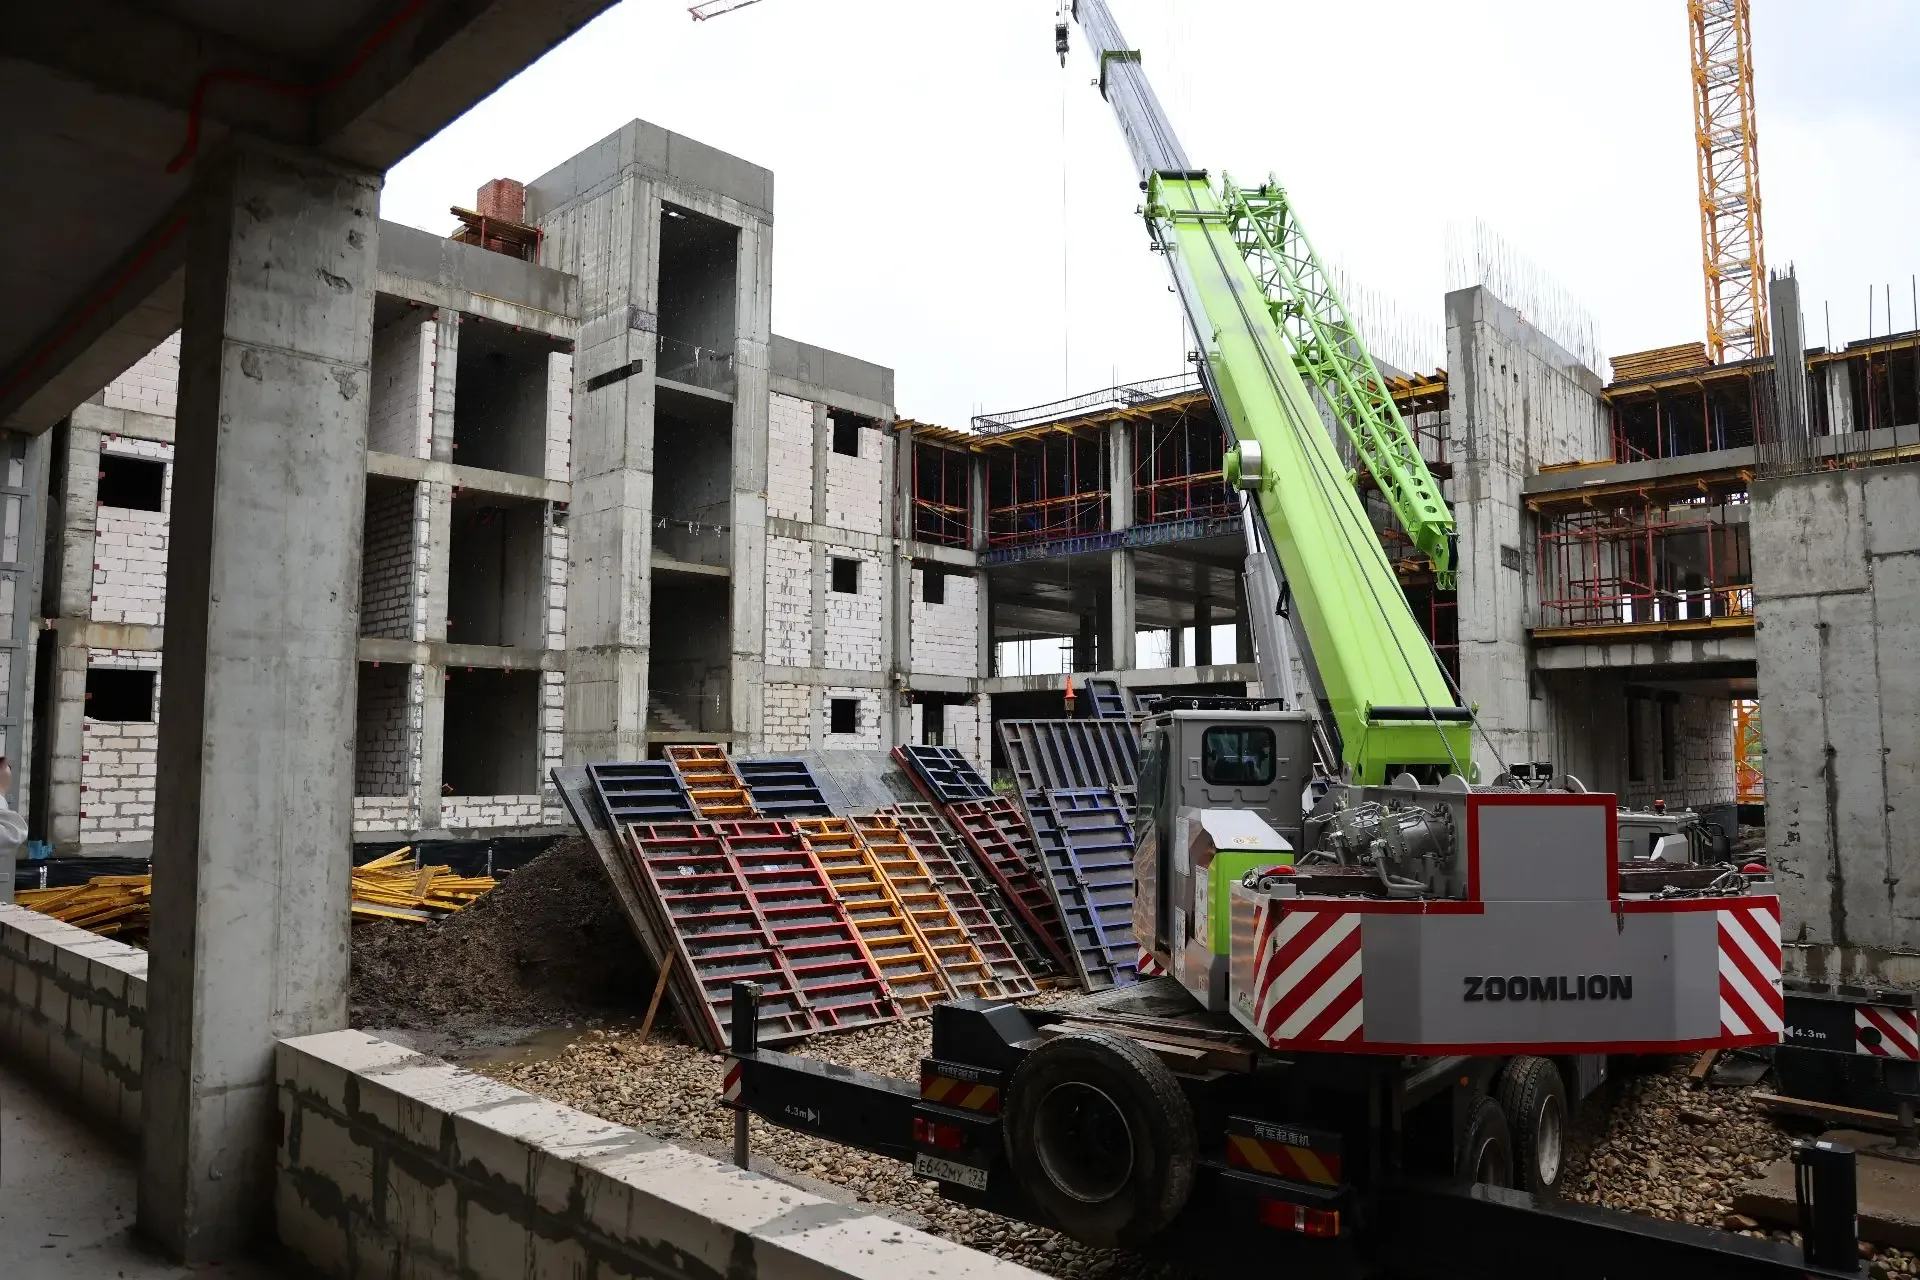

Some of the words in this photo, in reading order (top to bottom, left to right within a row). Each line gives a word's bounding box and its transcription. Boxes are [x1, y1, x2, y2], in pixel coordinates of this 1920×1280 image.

[1463, 974, 1633, 1002] ZOOMLION
[1795, 1028, 1827, 1039] 4.3m
[784, 1104, 807, 1119] 4.3m
[1254, 1124, 1310, 1147] 汽车起重机
